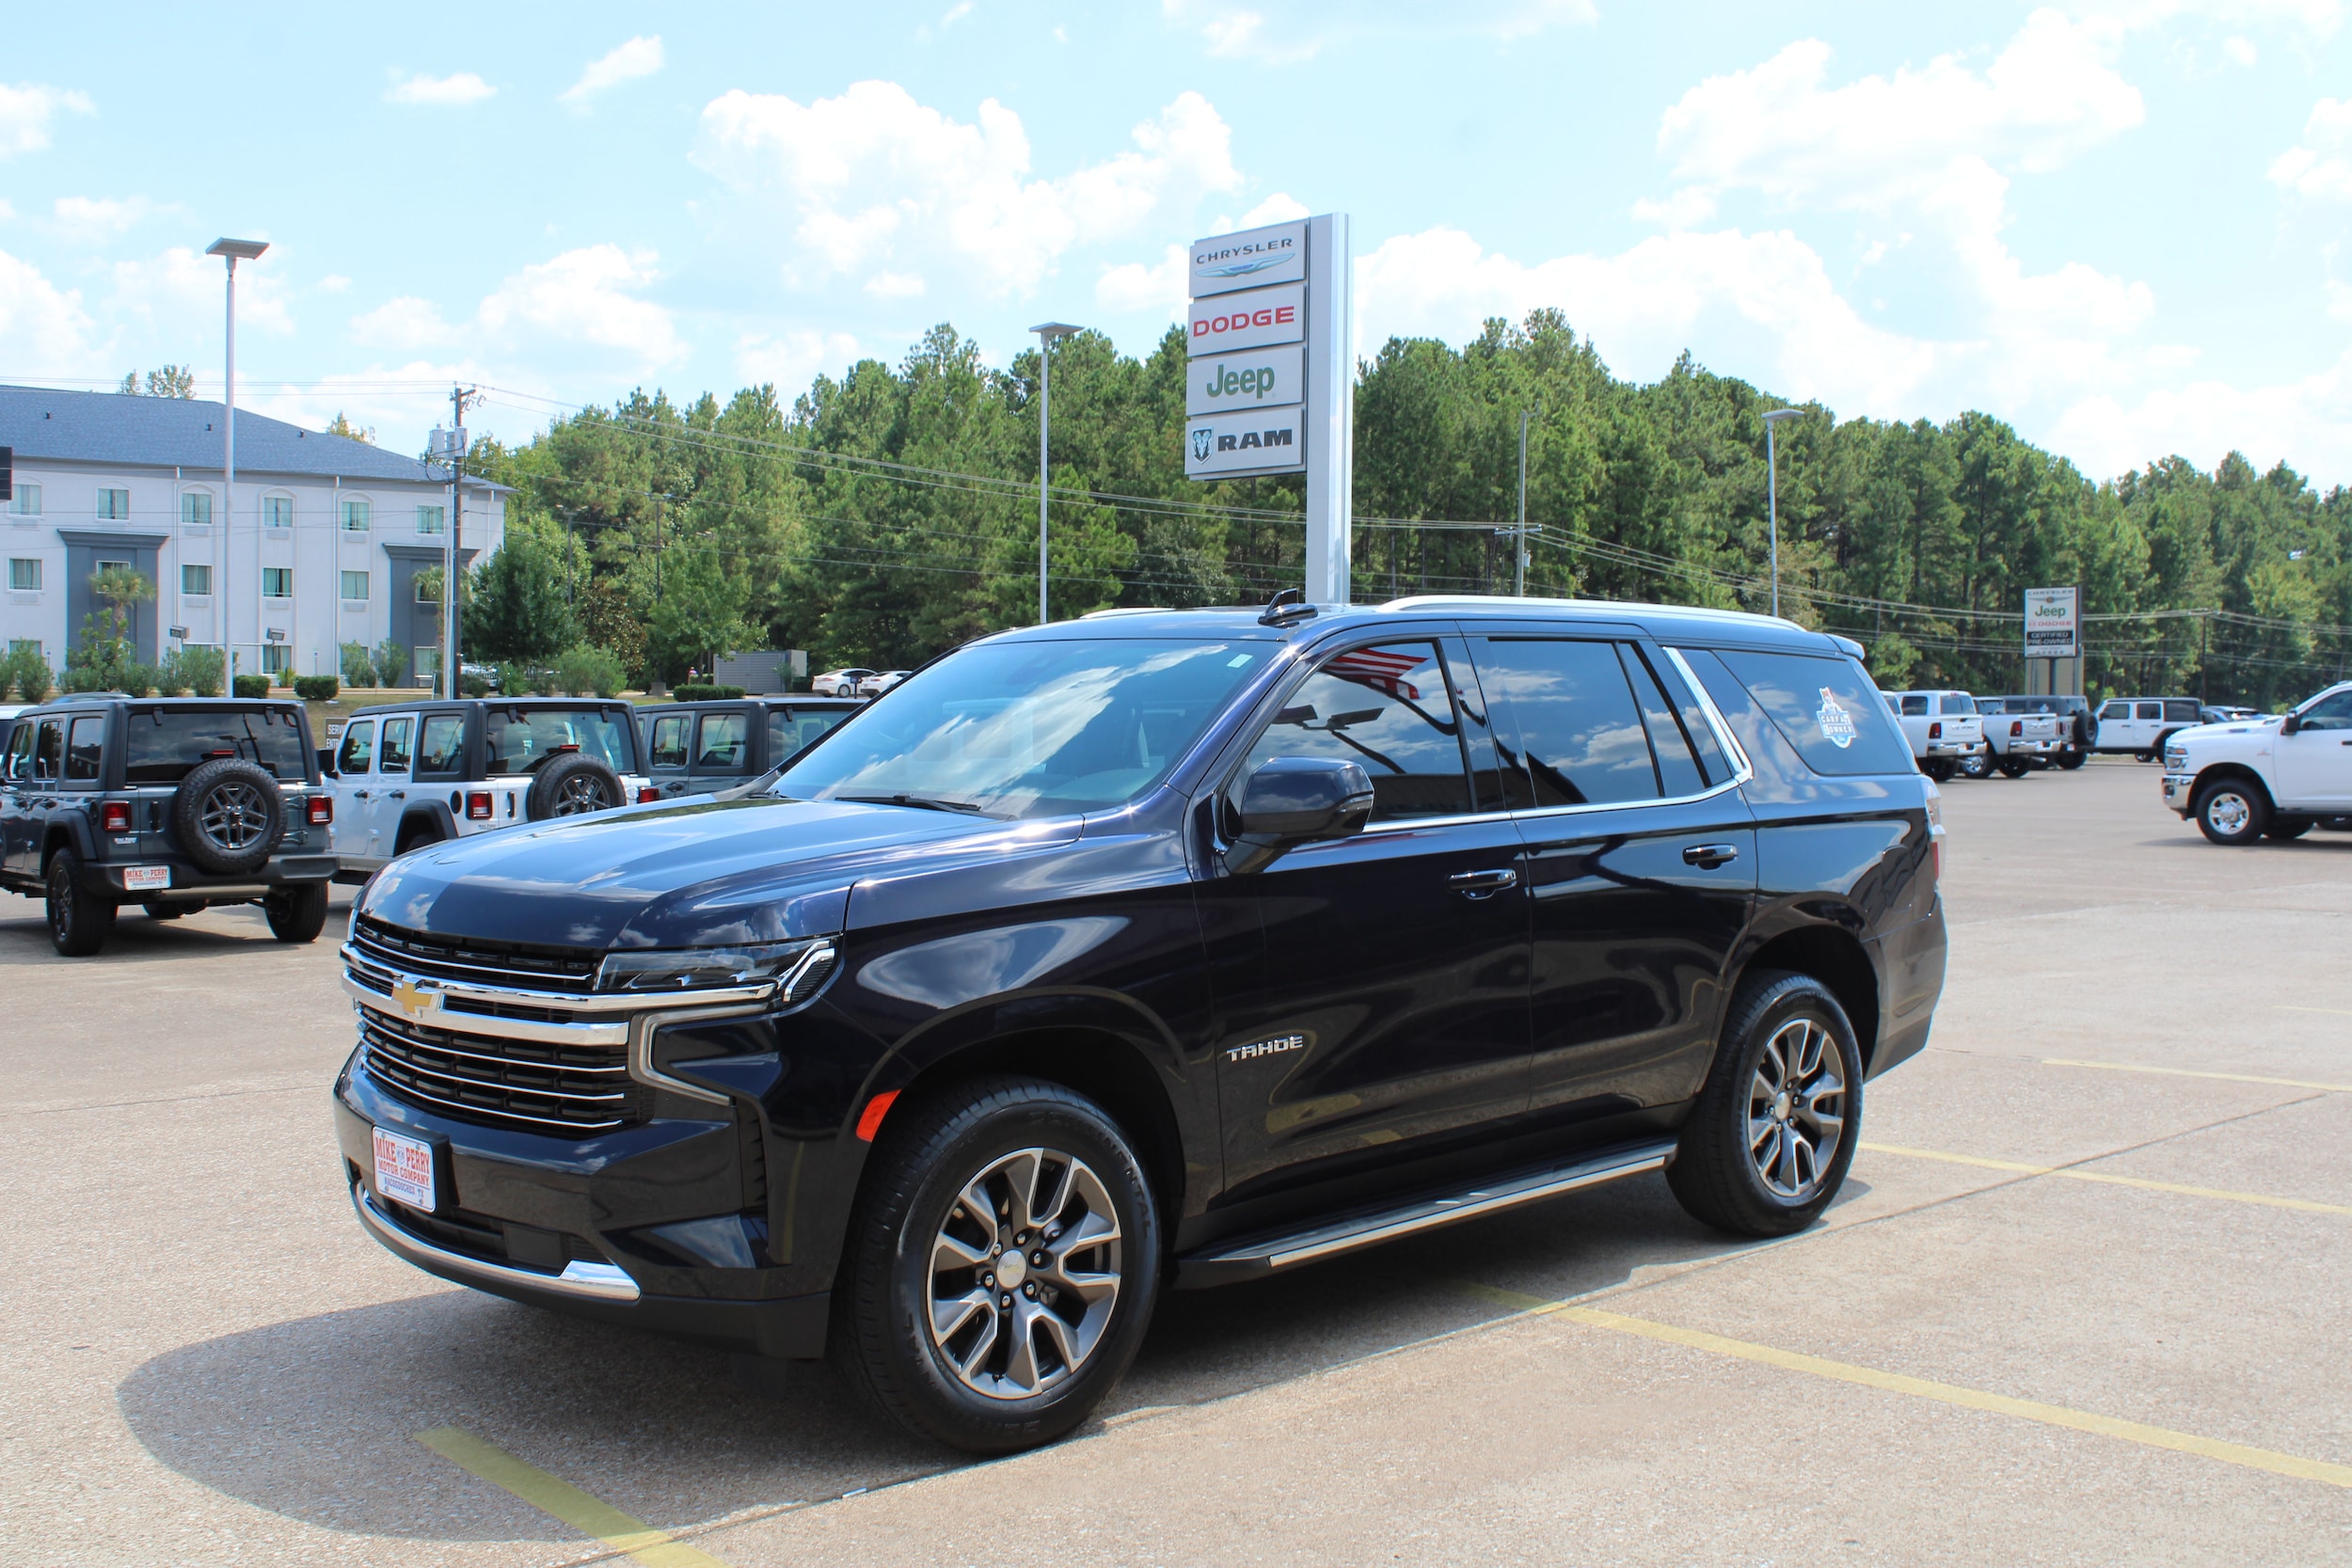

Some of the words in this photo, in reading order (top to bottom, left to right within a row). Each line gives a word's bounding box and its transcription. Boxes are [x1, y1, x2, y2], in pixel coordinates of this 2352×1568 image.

[1196, 237, 1293, 264] CHRYSLER
[1193, 306, 1295, 338] DODGE
[1206, 364, 1275, 399] Jeep
[1217, 429, 1293, 451] RAM
[2035, 605, 2066, 618] Jeep
[126, 869, 143, 878] MIKE
[151, 868, 167, 877] PERRY
[1226, 1036, 1303, 1062] TAHOE
[375, 1136, 396, 1163] MIKE
[405, 1147, 430, 1175] PERRY
[378, 1158, 399, 1176] MOTOR
[400, 1166, 430, 1186] COMPANY
